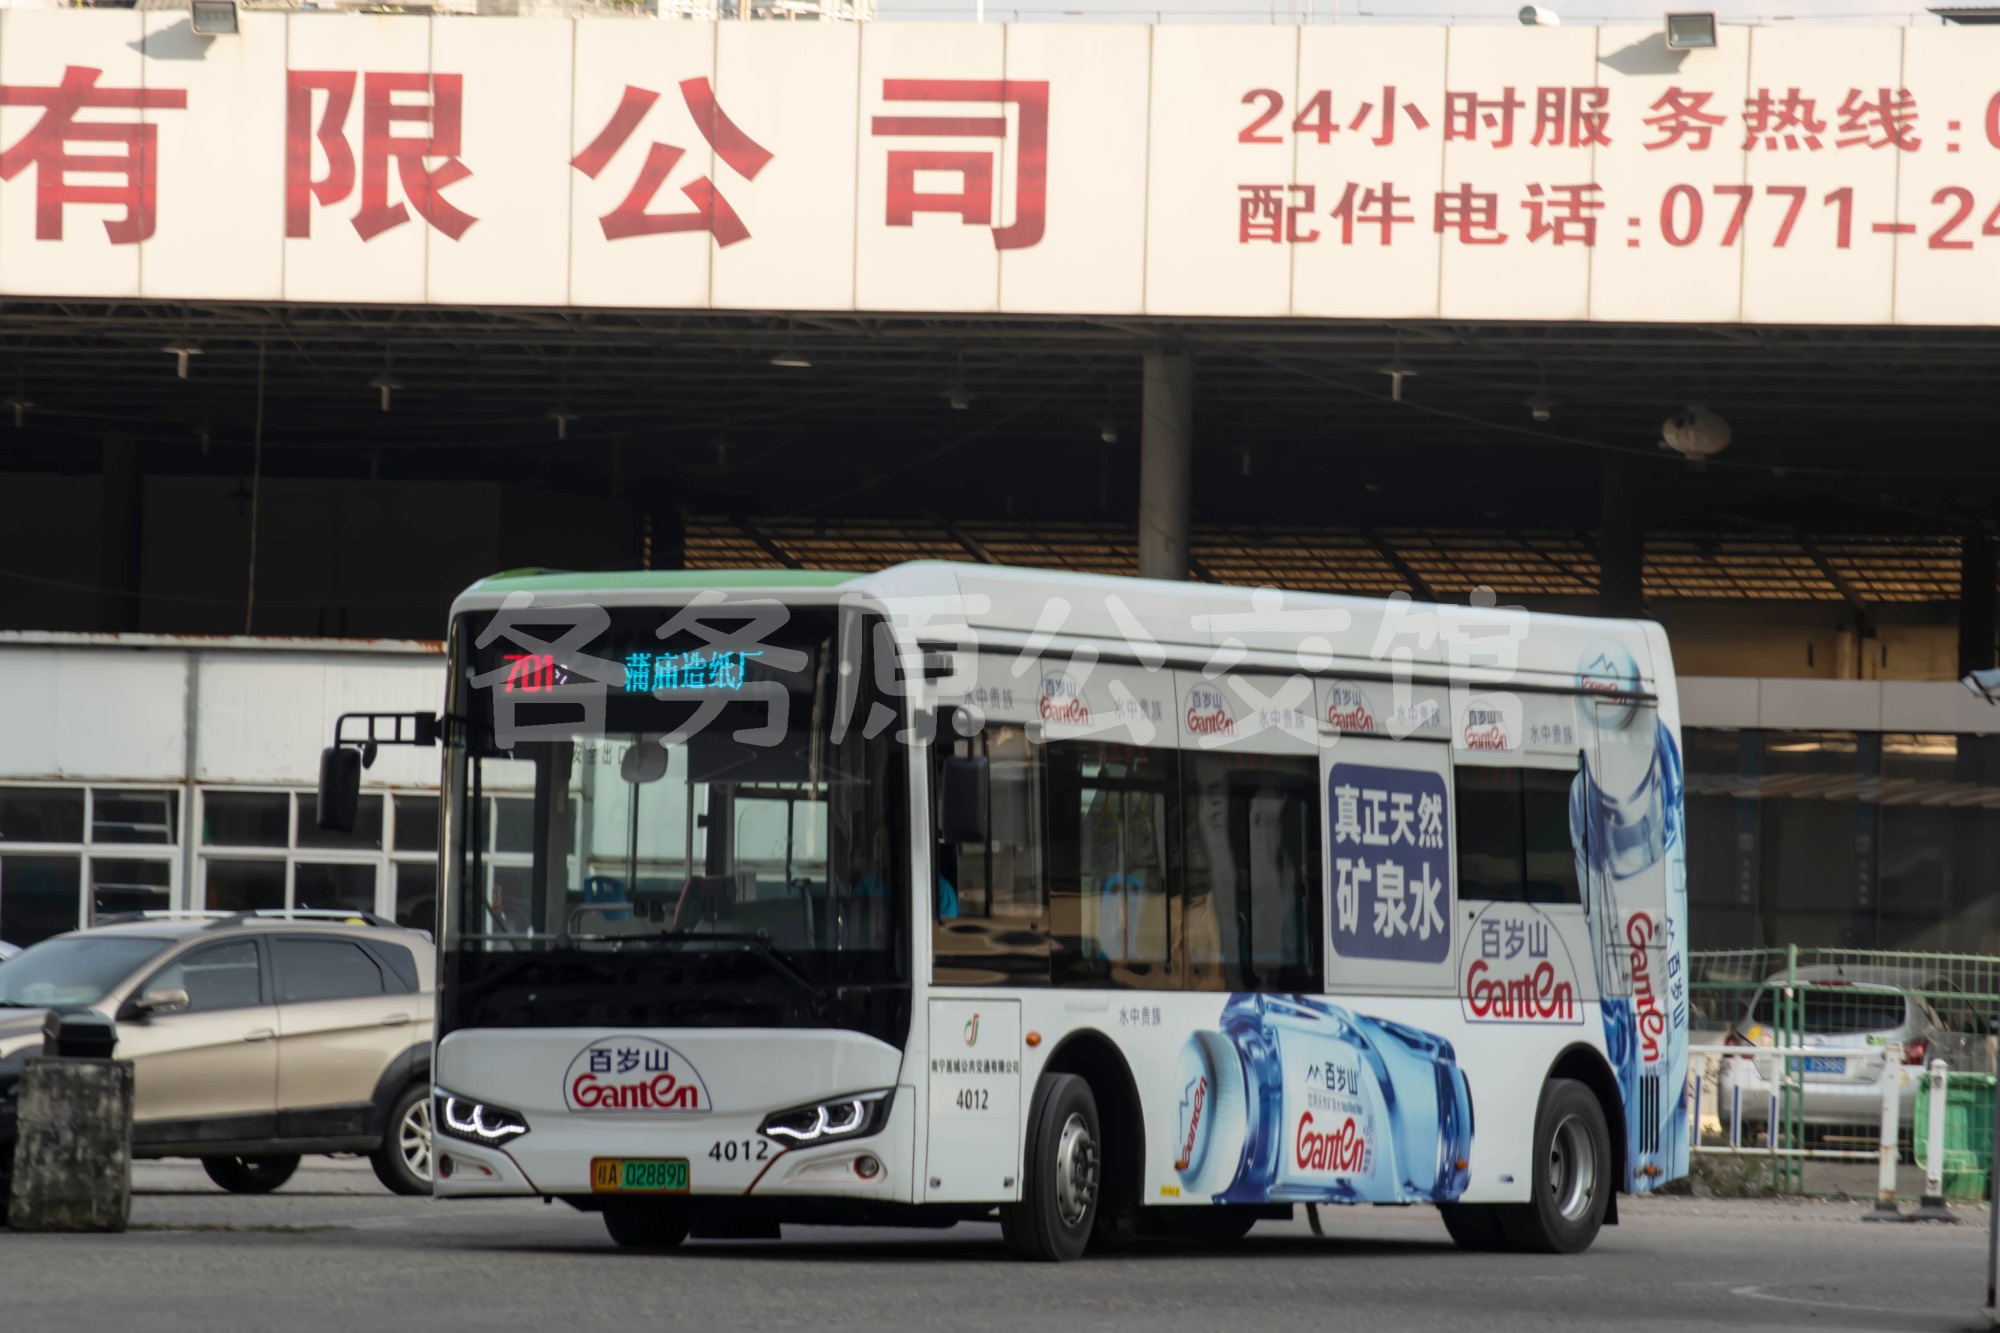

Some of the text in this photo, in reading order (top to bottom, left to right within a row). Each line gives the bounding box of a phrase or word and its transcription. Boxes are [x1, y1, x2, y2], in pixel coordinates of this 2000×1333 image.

[0, 65, 1049, 252] 有限公司
[504, 653, 554, 693] 701
[624, 650, 764, 693] 蒲庙造纸厂
[963, 687, 1014, 711] 水中贵族
[1046, 679, 1076, 697] 百岁山
[1192, 690, 1221, 709] 百岁山
[1333, 688, 1361, 706] 百岁山
[1116, 697, 1162, 721] 水中贵族
[1258, 707, 1305, 730] 水中贵族
[1530, 723, 1573, 745] 水中贵族
[1335, 784, 1443, 850] 真正天然
[1336, 857, 1444, 940] 矿泉水
[1481, 919, 1548, 960] 百岁山
[1119, 1005, 1161, 1026] 水中贵族
[589, 1048, 669, 1073] 百岁山
[1325, 1061, 1358, 1095] 百岁山
[956, 1088, 988, 1110] 4012
[708, 1141, 768, 1161] 4012
